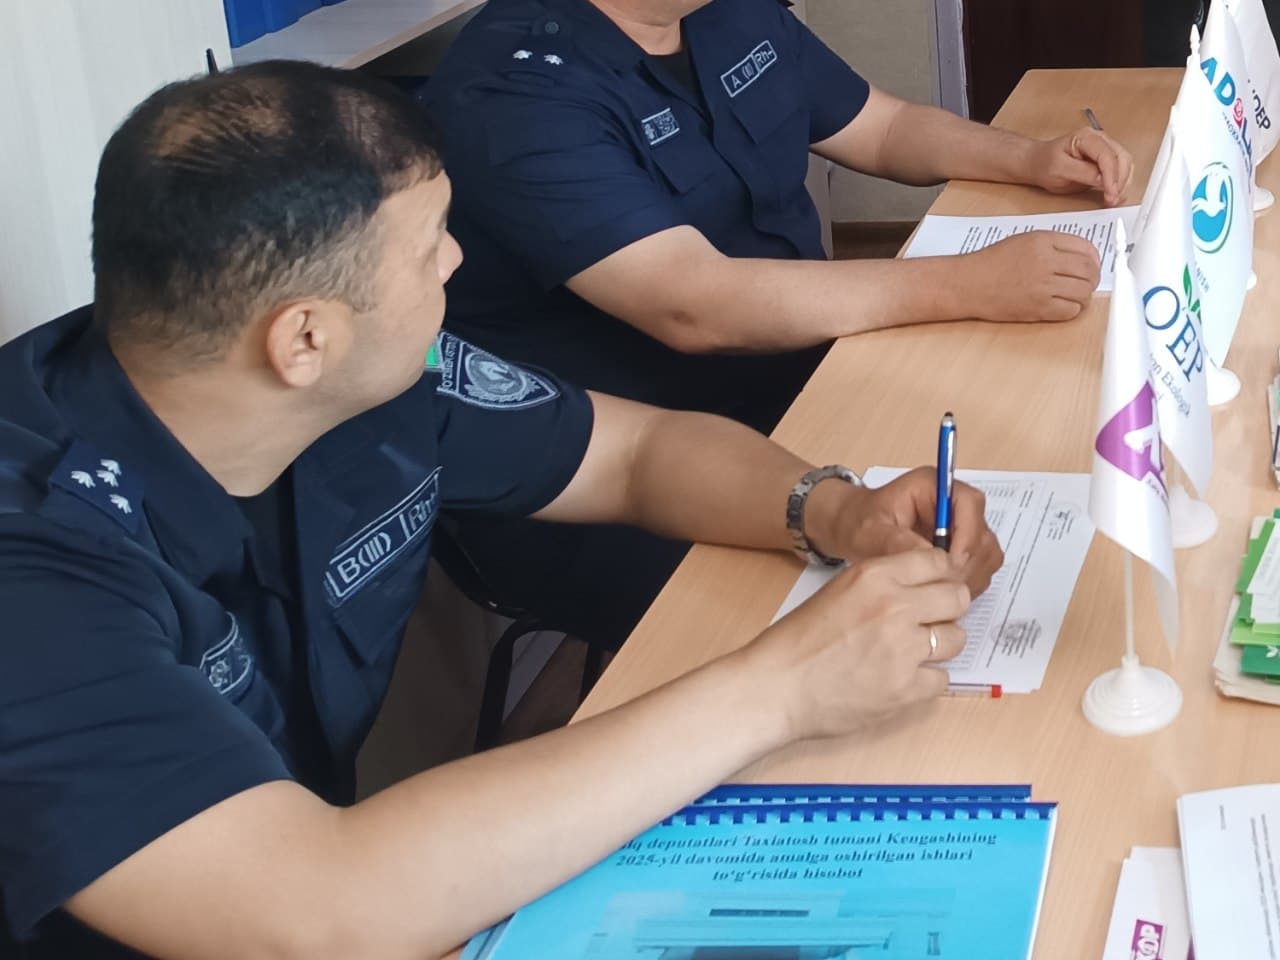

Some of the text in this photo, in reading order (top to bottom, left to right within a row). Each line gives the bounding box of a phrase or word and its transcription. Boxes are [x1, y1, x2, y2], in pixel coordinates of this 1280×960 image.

[731, 75, 742, 89] A
[647, 836, 737, 851] deputatlari
[743, 834, 818, 847] Taxiatosh
[823, 833, 882, 846] tumani
[886, 831, 998, 846] Kengashining
[616, 847, 974, 868] 2025-yil davomida amalga oshirilgan ishlari
[803, 866, 864, 880] hisobot
